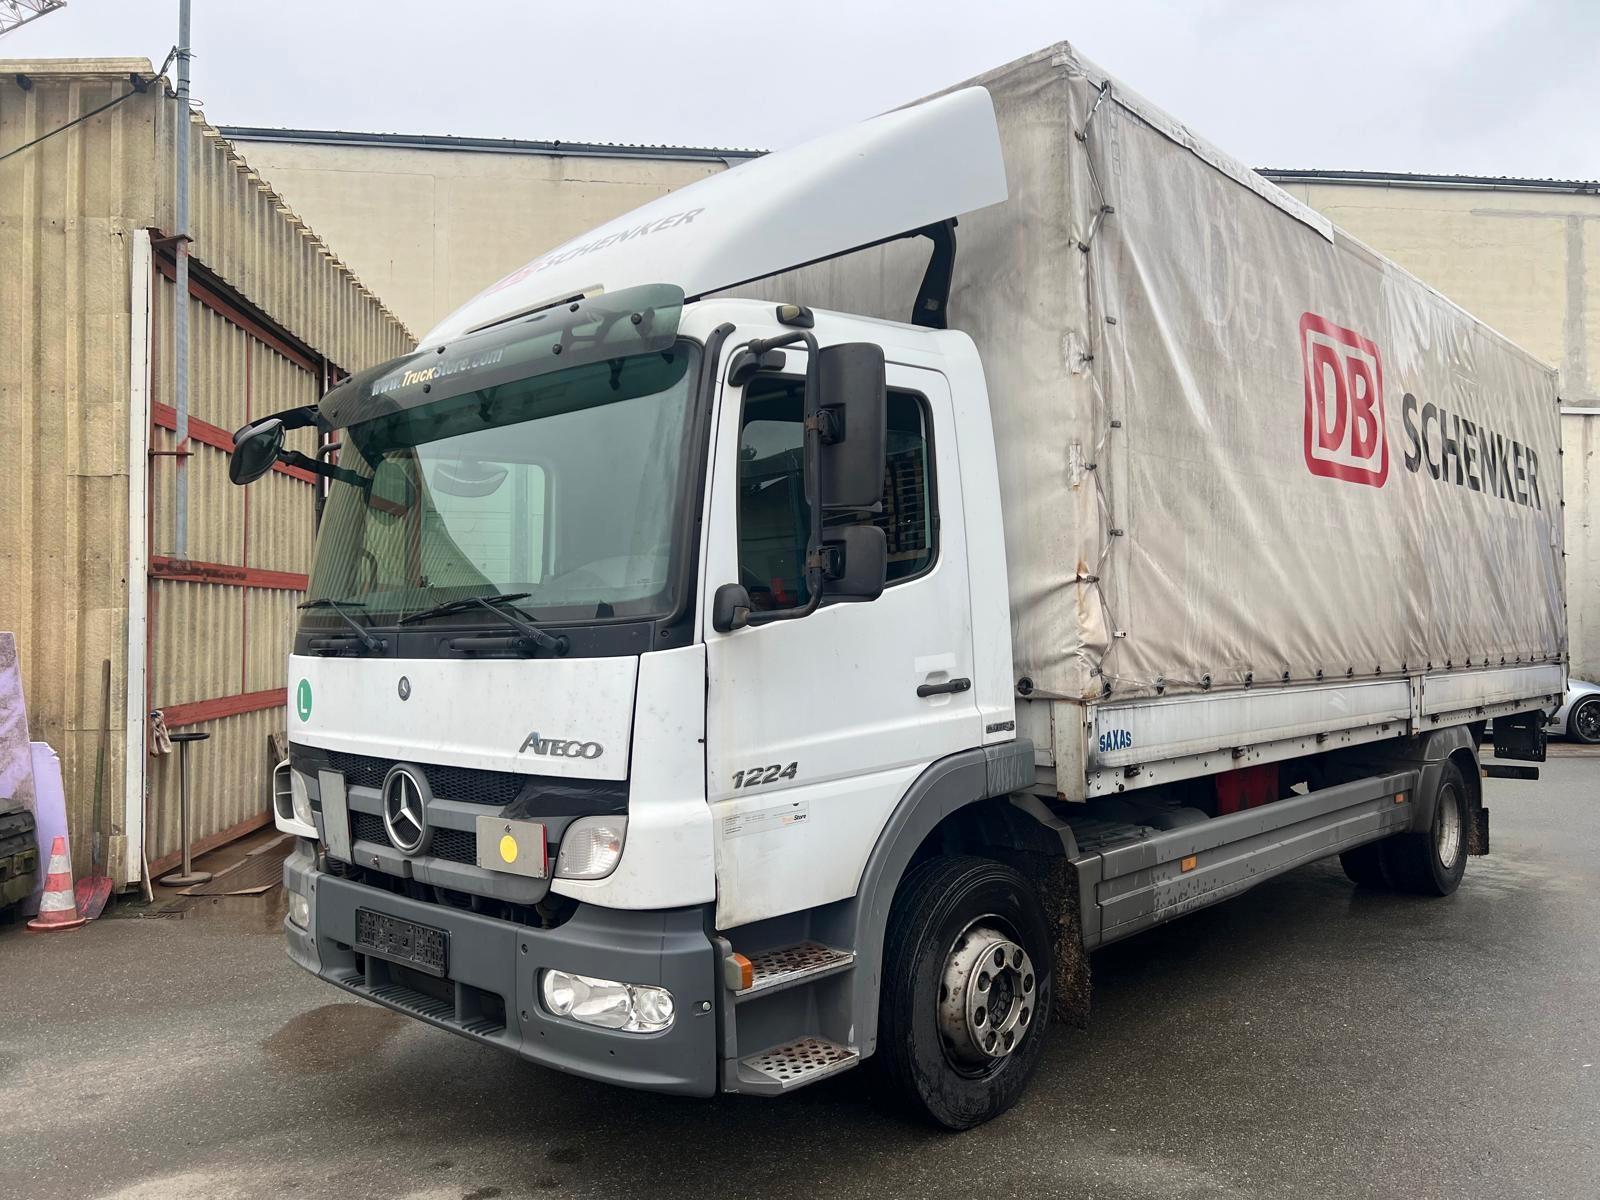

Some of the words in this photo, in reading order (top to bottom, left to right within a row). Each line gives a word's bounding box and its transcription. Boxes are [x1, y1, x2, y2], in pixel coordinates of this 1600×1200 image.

[536, 207, 706, 272] SCHENKER
[371, 349, 504, 396] www.TruckStore.com
[1312, 342, 1378, 460] DB
[1402, 393, 1542, 511] SCHENKER
[300, 687, 308, 713] L
[1099, 729, 1132, 753] SAXAS
[732, 761, 798, 789] 1224
